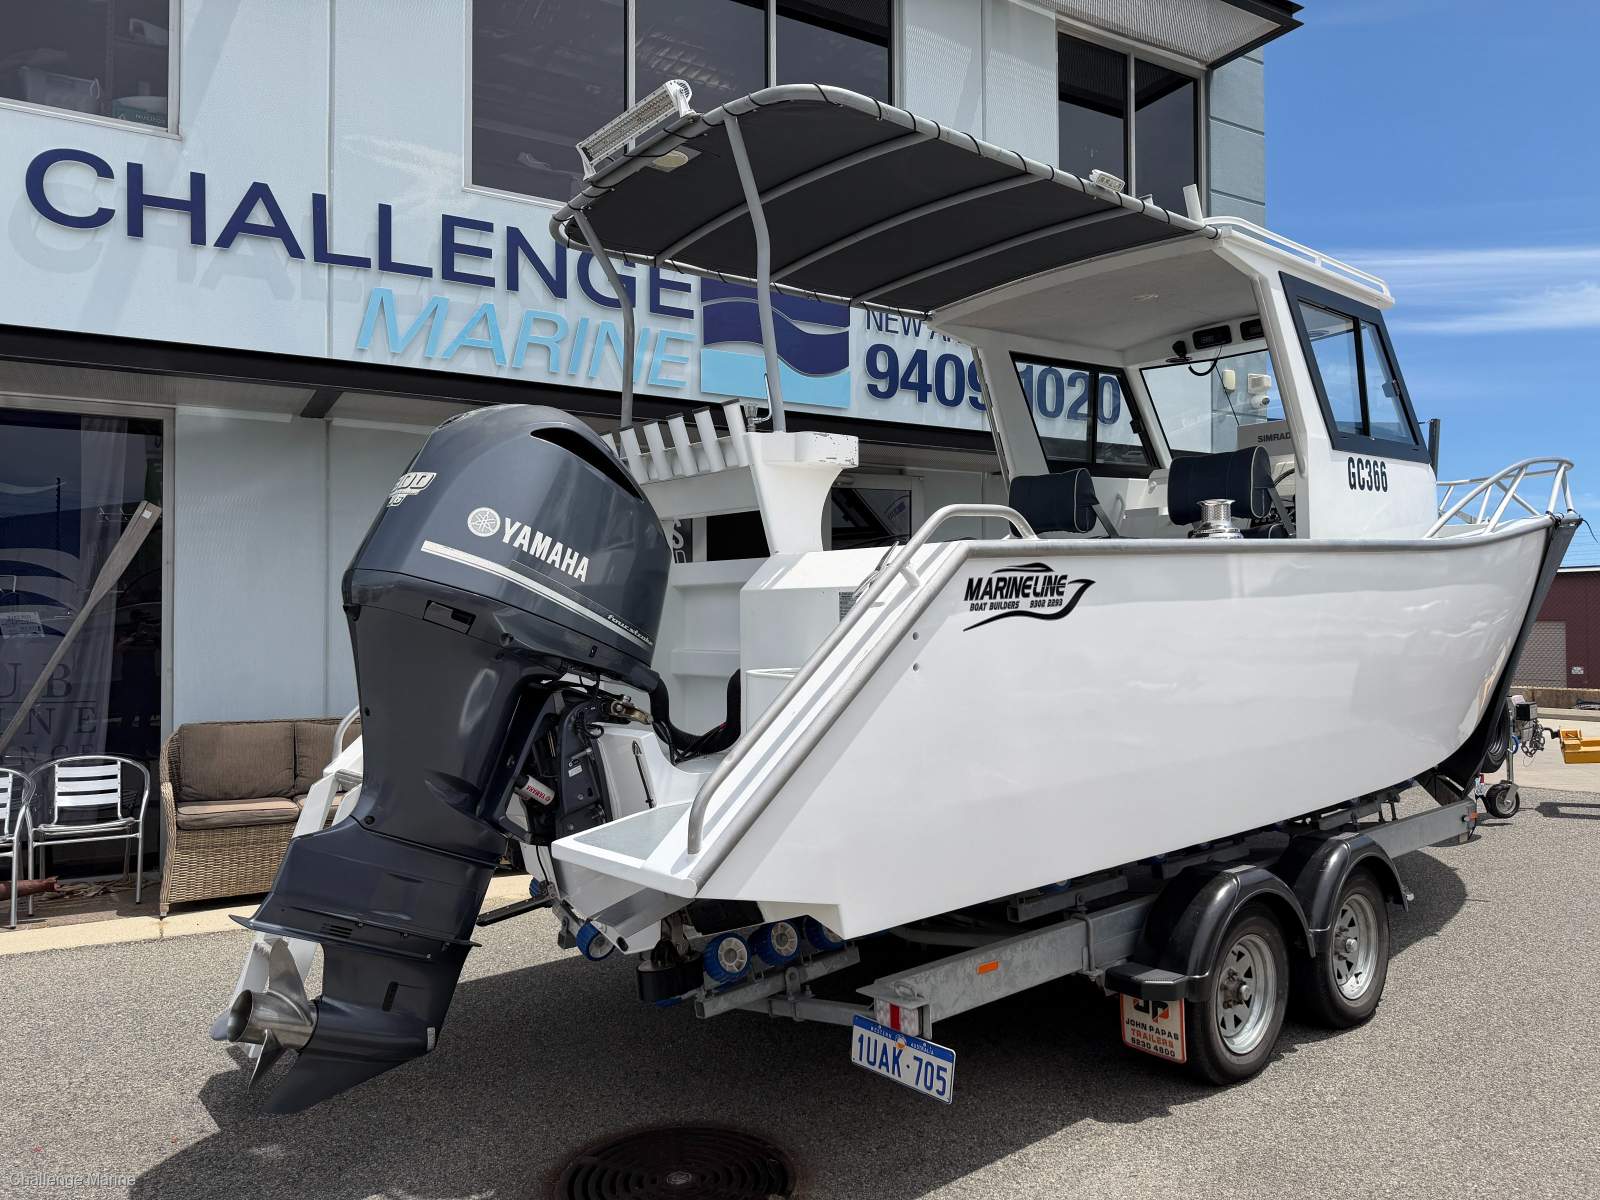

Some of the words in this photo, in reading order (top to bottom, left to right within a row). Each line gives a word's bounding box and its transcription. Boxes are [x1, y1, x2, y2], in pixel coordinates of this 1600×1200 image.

[25, 148, 695, 320] CHALLENGE
[357, 287, 696, 388] MARINE
[864, 309, 923, 338] NEW
[1018, 364, 1121, 425] 1020
[1257, 431, 1291, 443] SIMRAD
[1347, 456, 1388, 493] GC366
[501, 517, 590, 583] YAMAHA
[963, 574, 1068, 602] MARINELINE
[970, 602, 988, 612] BOAT
[989, 600, 1020, 611] BUILDERS
[1126, 1018, 1147, 1031] JOHN
